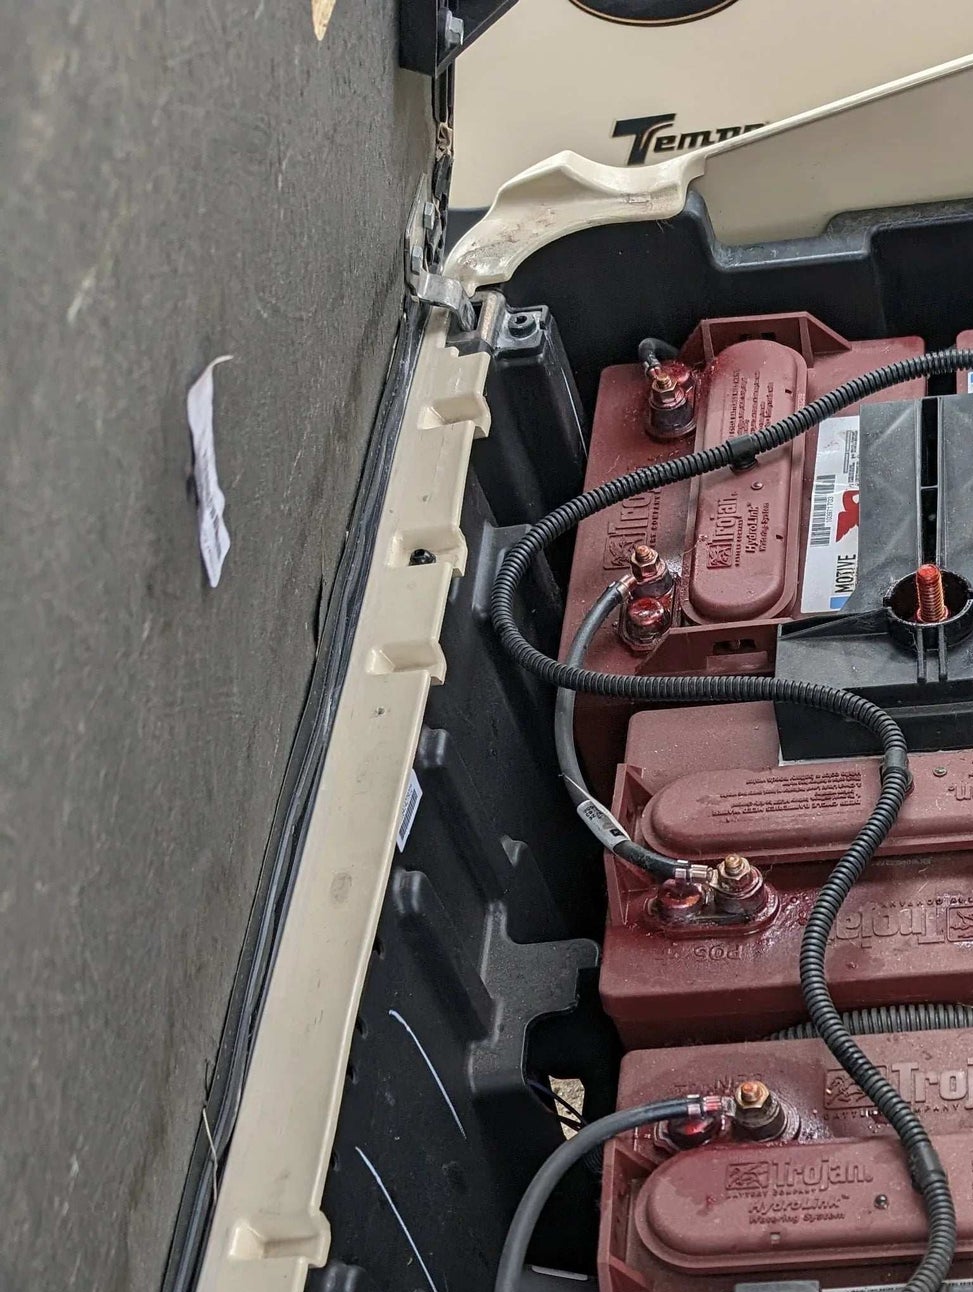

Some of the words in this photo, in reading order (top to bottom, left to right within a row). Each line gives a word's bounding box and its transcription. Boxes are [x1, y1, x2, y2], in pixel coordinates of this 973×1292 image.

[611, 113, 769, 166] Temp
[710, 492, 738, 546] Trojan
[834, 553, 857, 596] MOTIVE
[772, 1157, 867, 1192] Trojan
